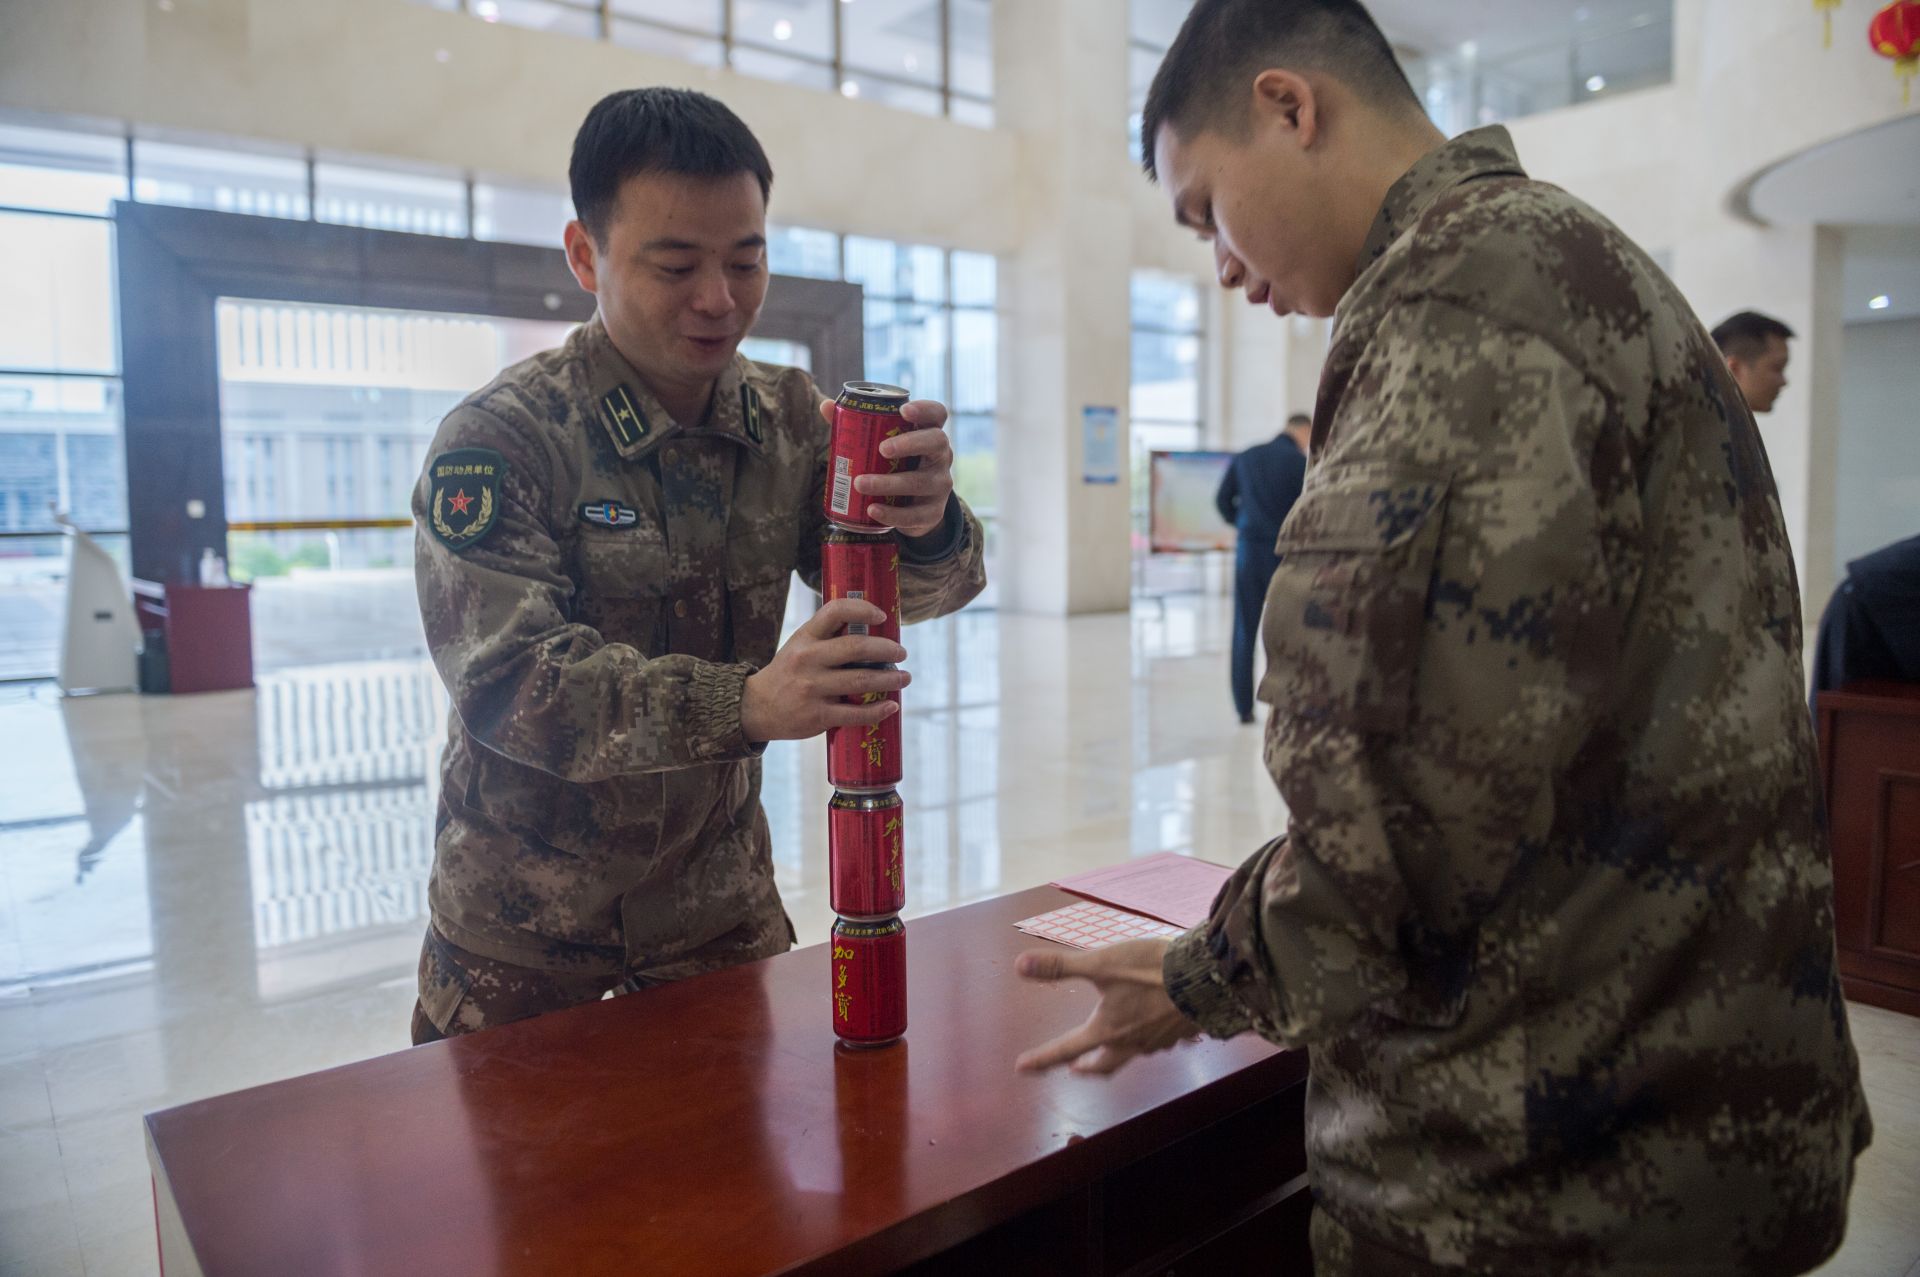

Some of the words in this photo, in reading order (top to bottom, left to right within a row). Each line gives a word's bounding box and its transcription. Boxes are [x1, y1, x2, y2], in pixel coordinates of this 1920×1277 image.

[437, 465, 494, 477] 国防动员单位
